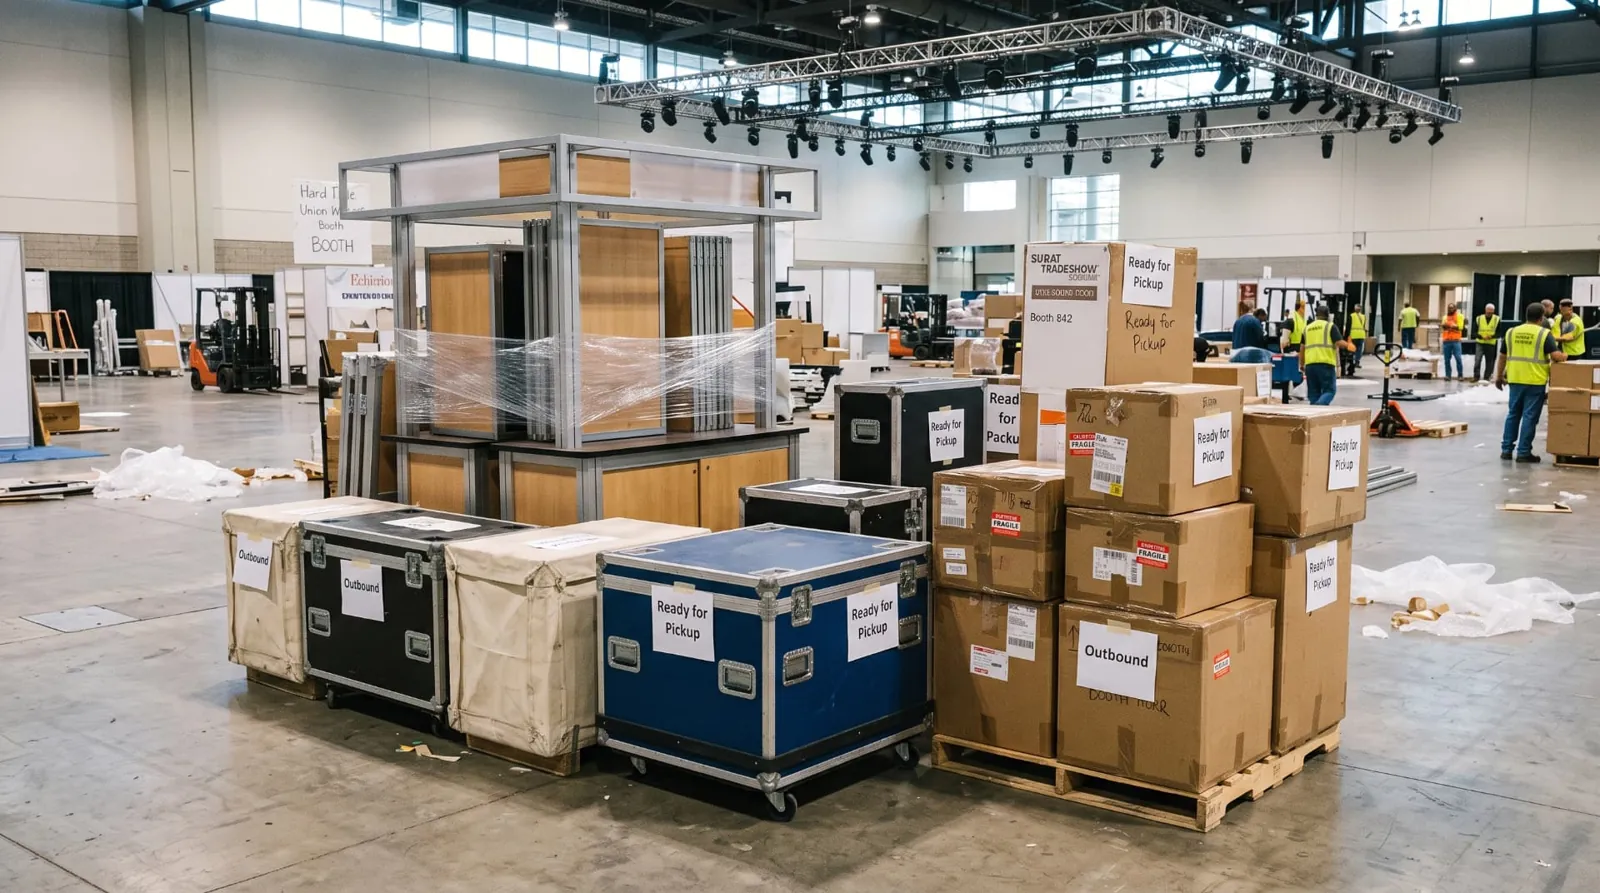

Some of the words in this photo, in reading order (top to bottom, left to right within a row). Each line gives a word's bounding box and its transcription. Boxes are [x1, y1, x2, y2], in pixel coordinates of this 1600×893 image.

[300, 184, 327, 199] Hard
[299, 204, 328, 216] Union
[318, 219, 345, 231] Booth
[311, 236, 354, 253] BOOTH
[1031, 253, 1062, 264] SURAT
[1128, 256, 1155, 273] Ready
[1157, 258, 1171, 272] for
[1041, 264, 1098, 274] TRADESHOW
[1133, 276, 1163, 293] Pickup
[1030, 313, 1054, 323] Booth
[1056, 313, 1073, 323] 842
[1125, 310, 1155, 334] Ready
[1159, 312, 1175, 329] for
[1132, 334, 1166, 354] Pickup
[989, 392, 1019, 405] Read
[930, 421, 951, 432] Ready
[951, 419, 962, 430] for
[998, 411, 1017, 425] for
[935, 436, 957, 447] Pickup
[986, 430, 1020, 445] Packu
[1197, 430, 1218, 444] Ready
[1219, 427, 1230, 439] for
[1331, 440, 1349, 453] Ready
[1349, 439, 1358, 450] for
[1202, 449, 1225, 464] Pickup
[1335, 458, 1354, 472] Pickup
[993, 519, 1020, 530] FRAGILE
[238, 549, 269, 566] Outbound
[1137, 548, 1167, 561] FRAGILE
[1309, 559, 1326, 573] Ready
[1326, 556, 1335, 567] for
[343, 578, 380, 594] Outbound
[1313, 576, 1332, 591] Pickup
[657, 600, 690, 620] Ready
[691, 604, 708, 620] for
[851, 603, 879, 621] Ready
[879, 599, 893, 613] for
[665, 621, 701, 641] Pickup
[857, 621, 888, 640] Pickup
[1084, 644, 1149, 668] Outbound
